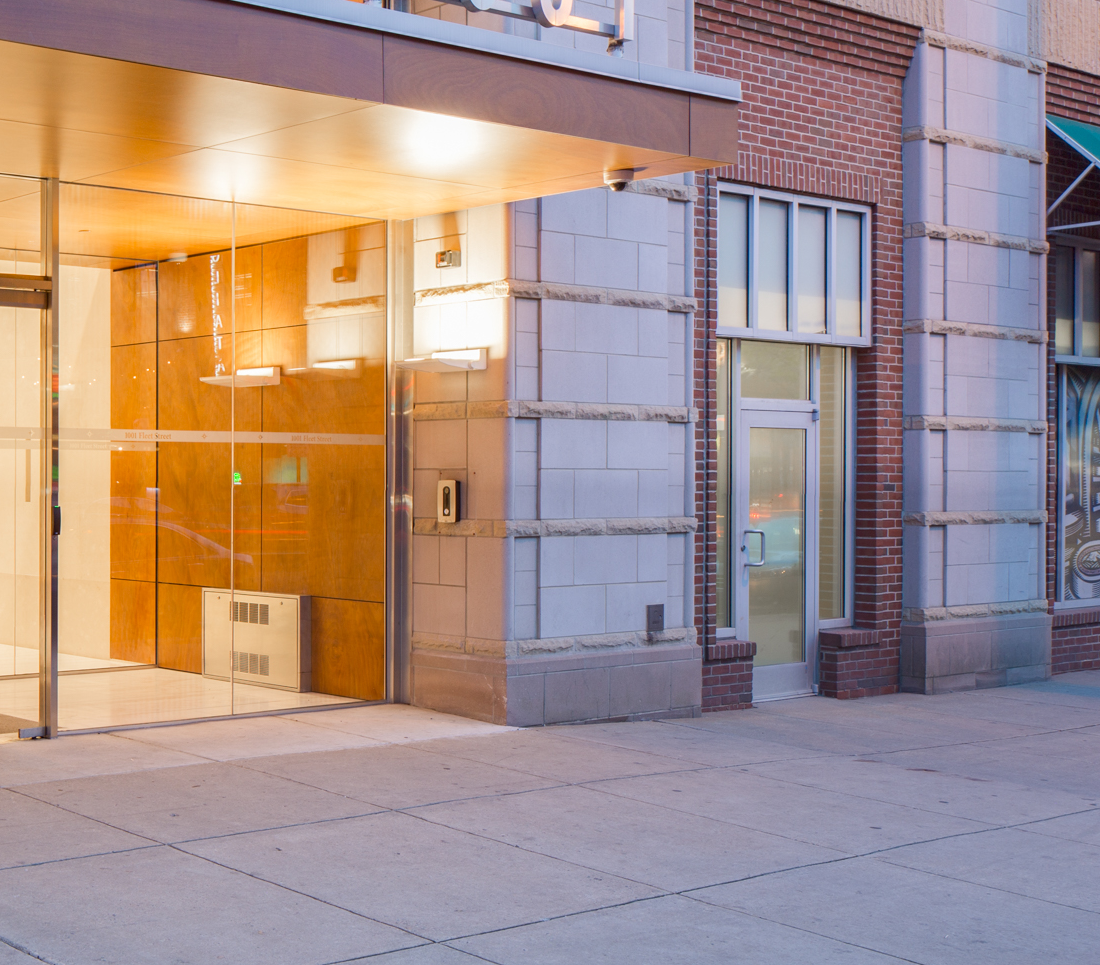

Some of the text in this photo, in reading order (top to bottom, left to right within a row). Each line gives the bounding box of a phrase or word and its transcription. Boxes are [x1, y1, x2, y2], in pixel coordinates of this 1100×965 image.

[124, 431, 172, 440] 1001 Fleet Street
